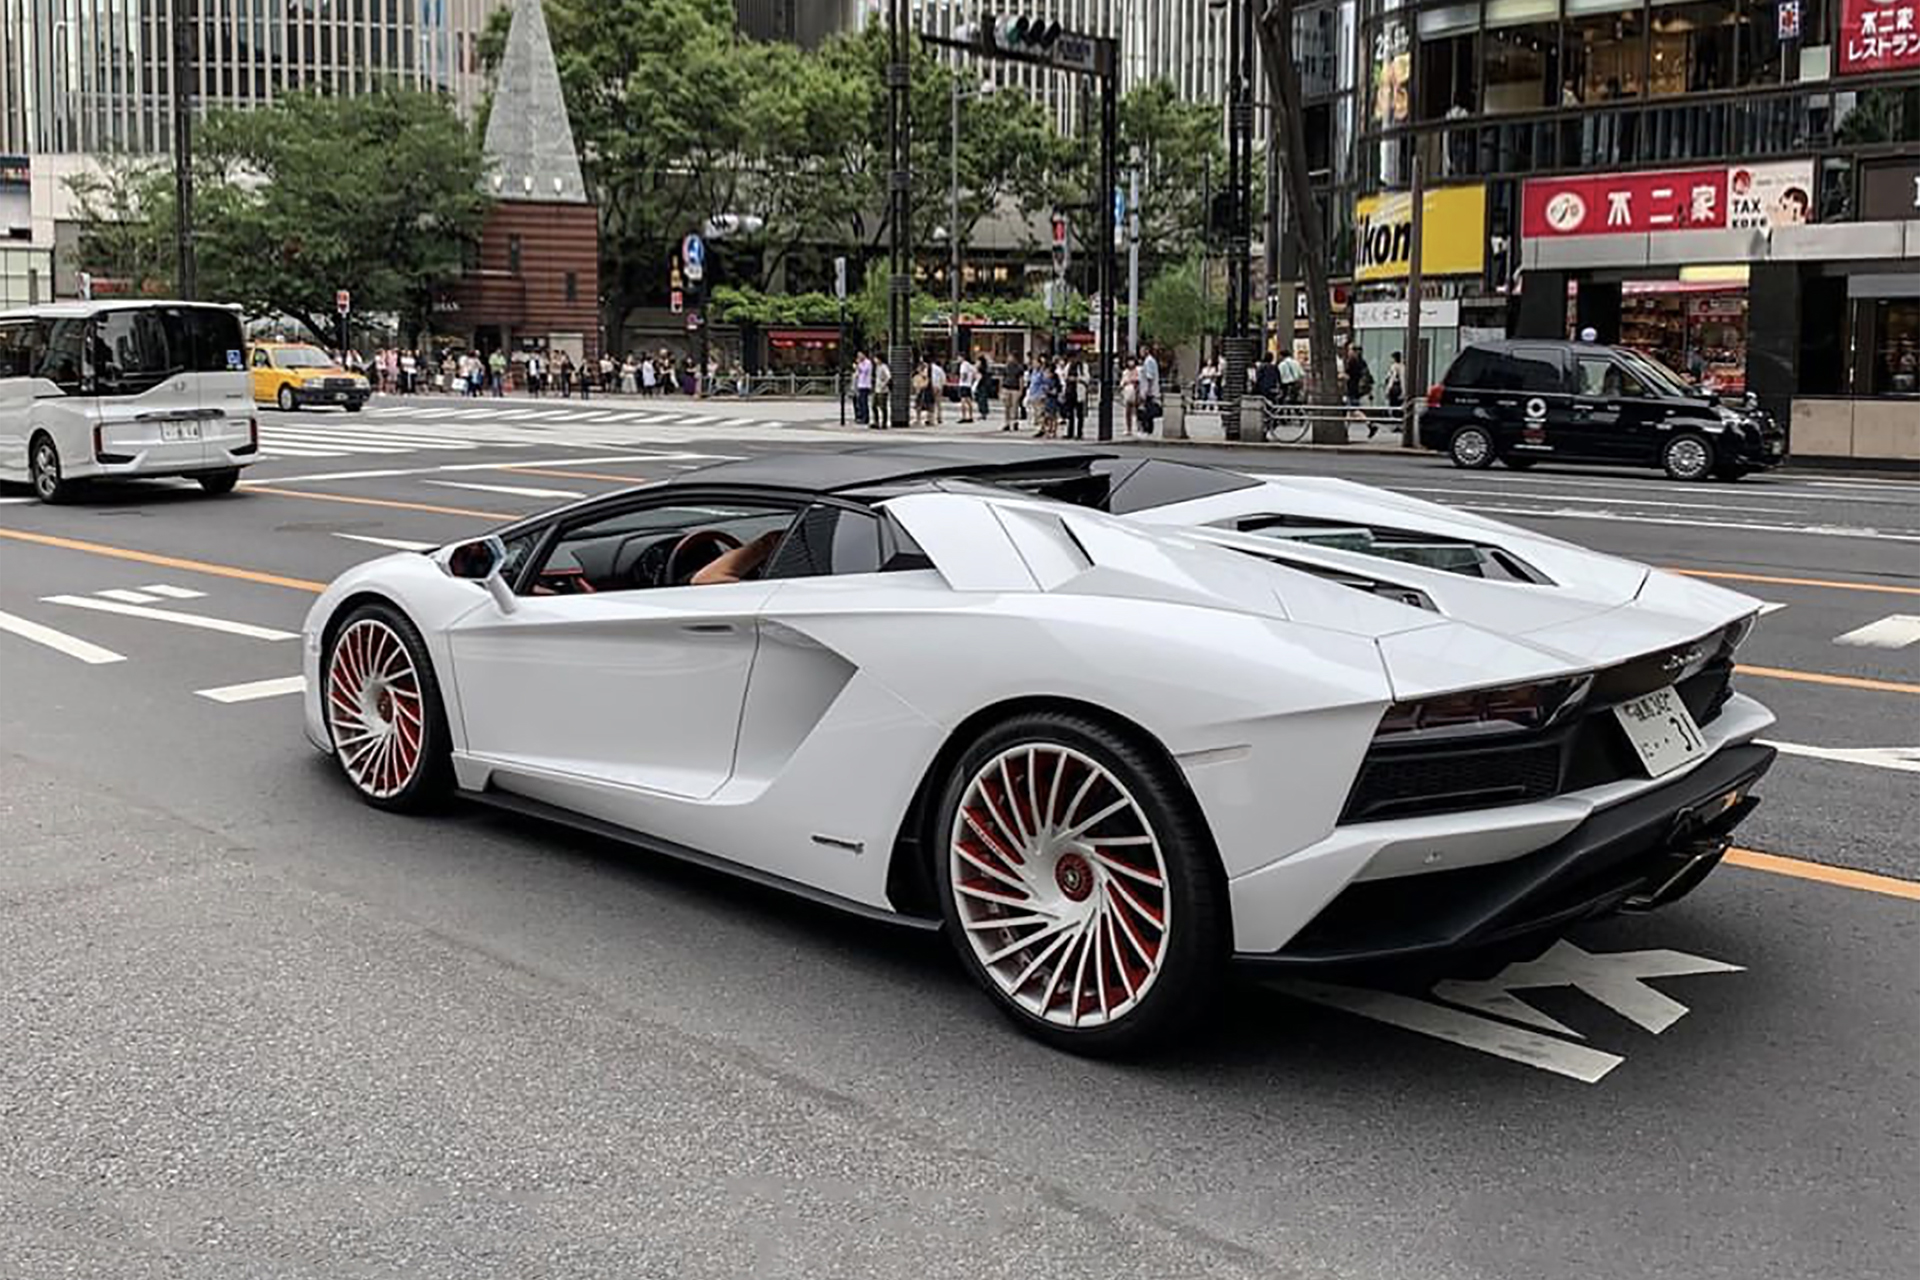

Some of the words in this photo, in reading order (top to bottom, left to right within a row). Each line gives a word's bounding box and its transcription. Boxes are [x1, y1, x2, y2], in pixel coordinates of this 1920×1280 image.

[1861, 7, 1914, 35] 不二家
[1849, 33, 1920, 61] レストラン
[1607, 184, 1716, 226] 不二家
[1732, 198, 1762, 214] TAX
[1669, 712, 1702, 752] 31
